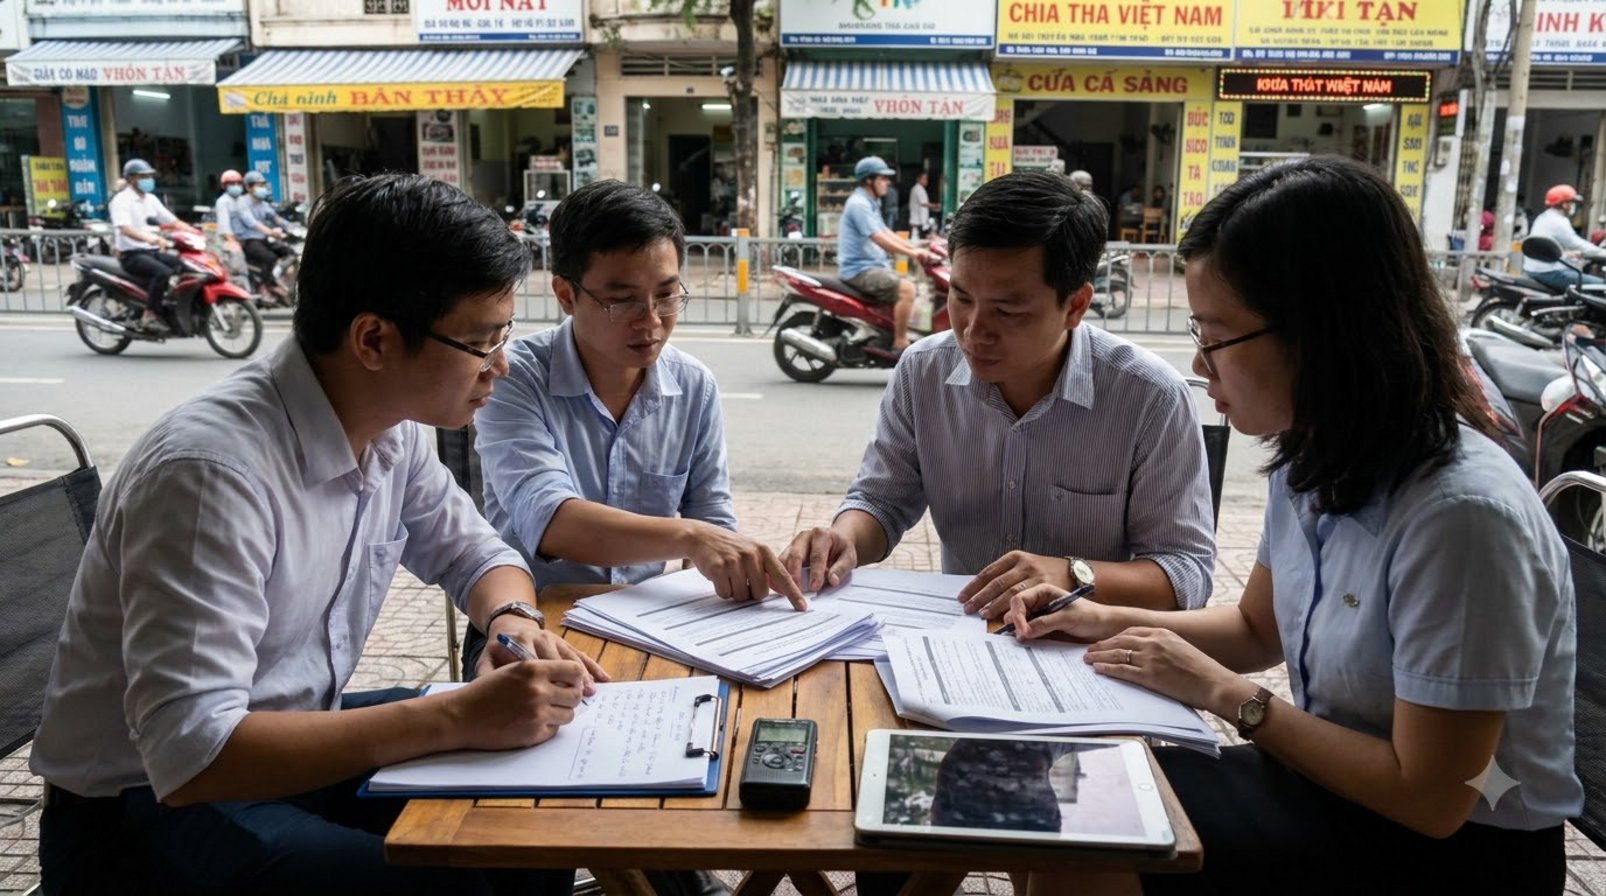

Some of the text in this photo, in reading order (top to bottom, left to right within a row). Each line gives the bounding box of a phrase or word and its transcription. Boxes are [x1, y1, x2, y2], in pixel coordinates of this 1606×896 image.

[1009, 0, 1222, 30] CHIA THA VIỆT NAM
